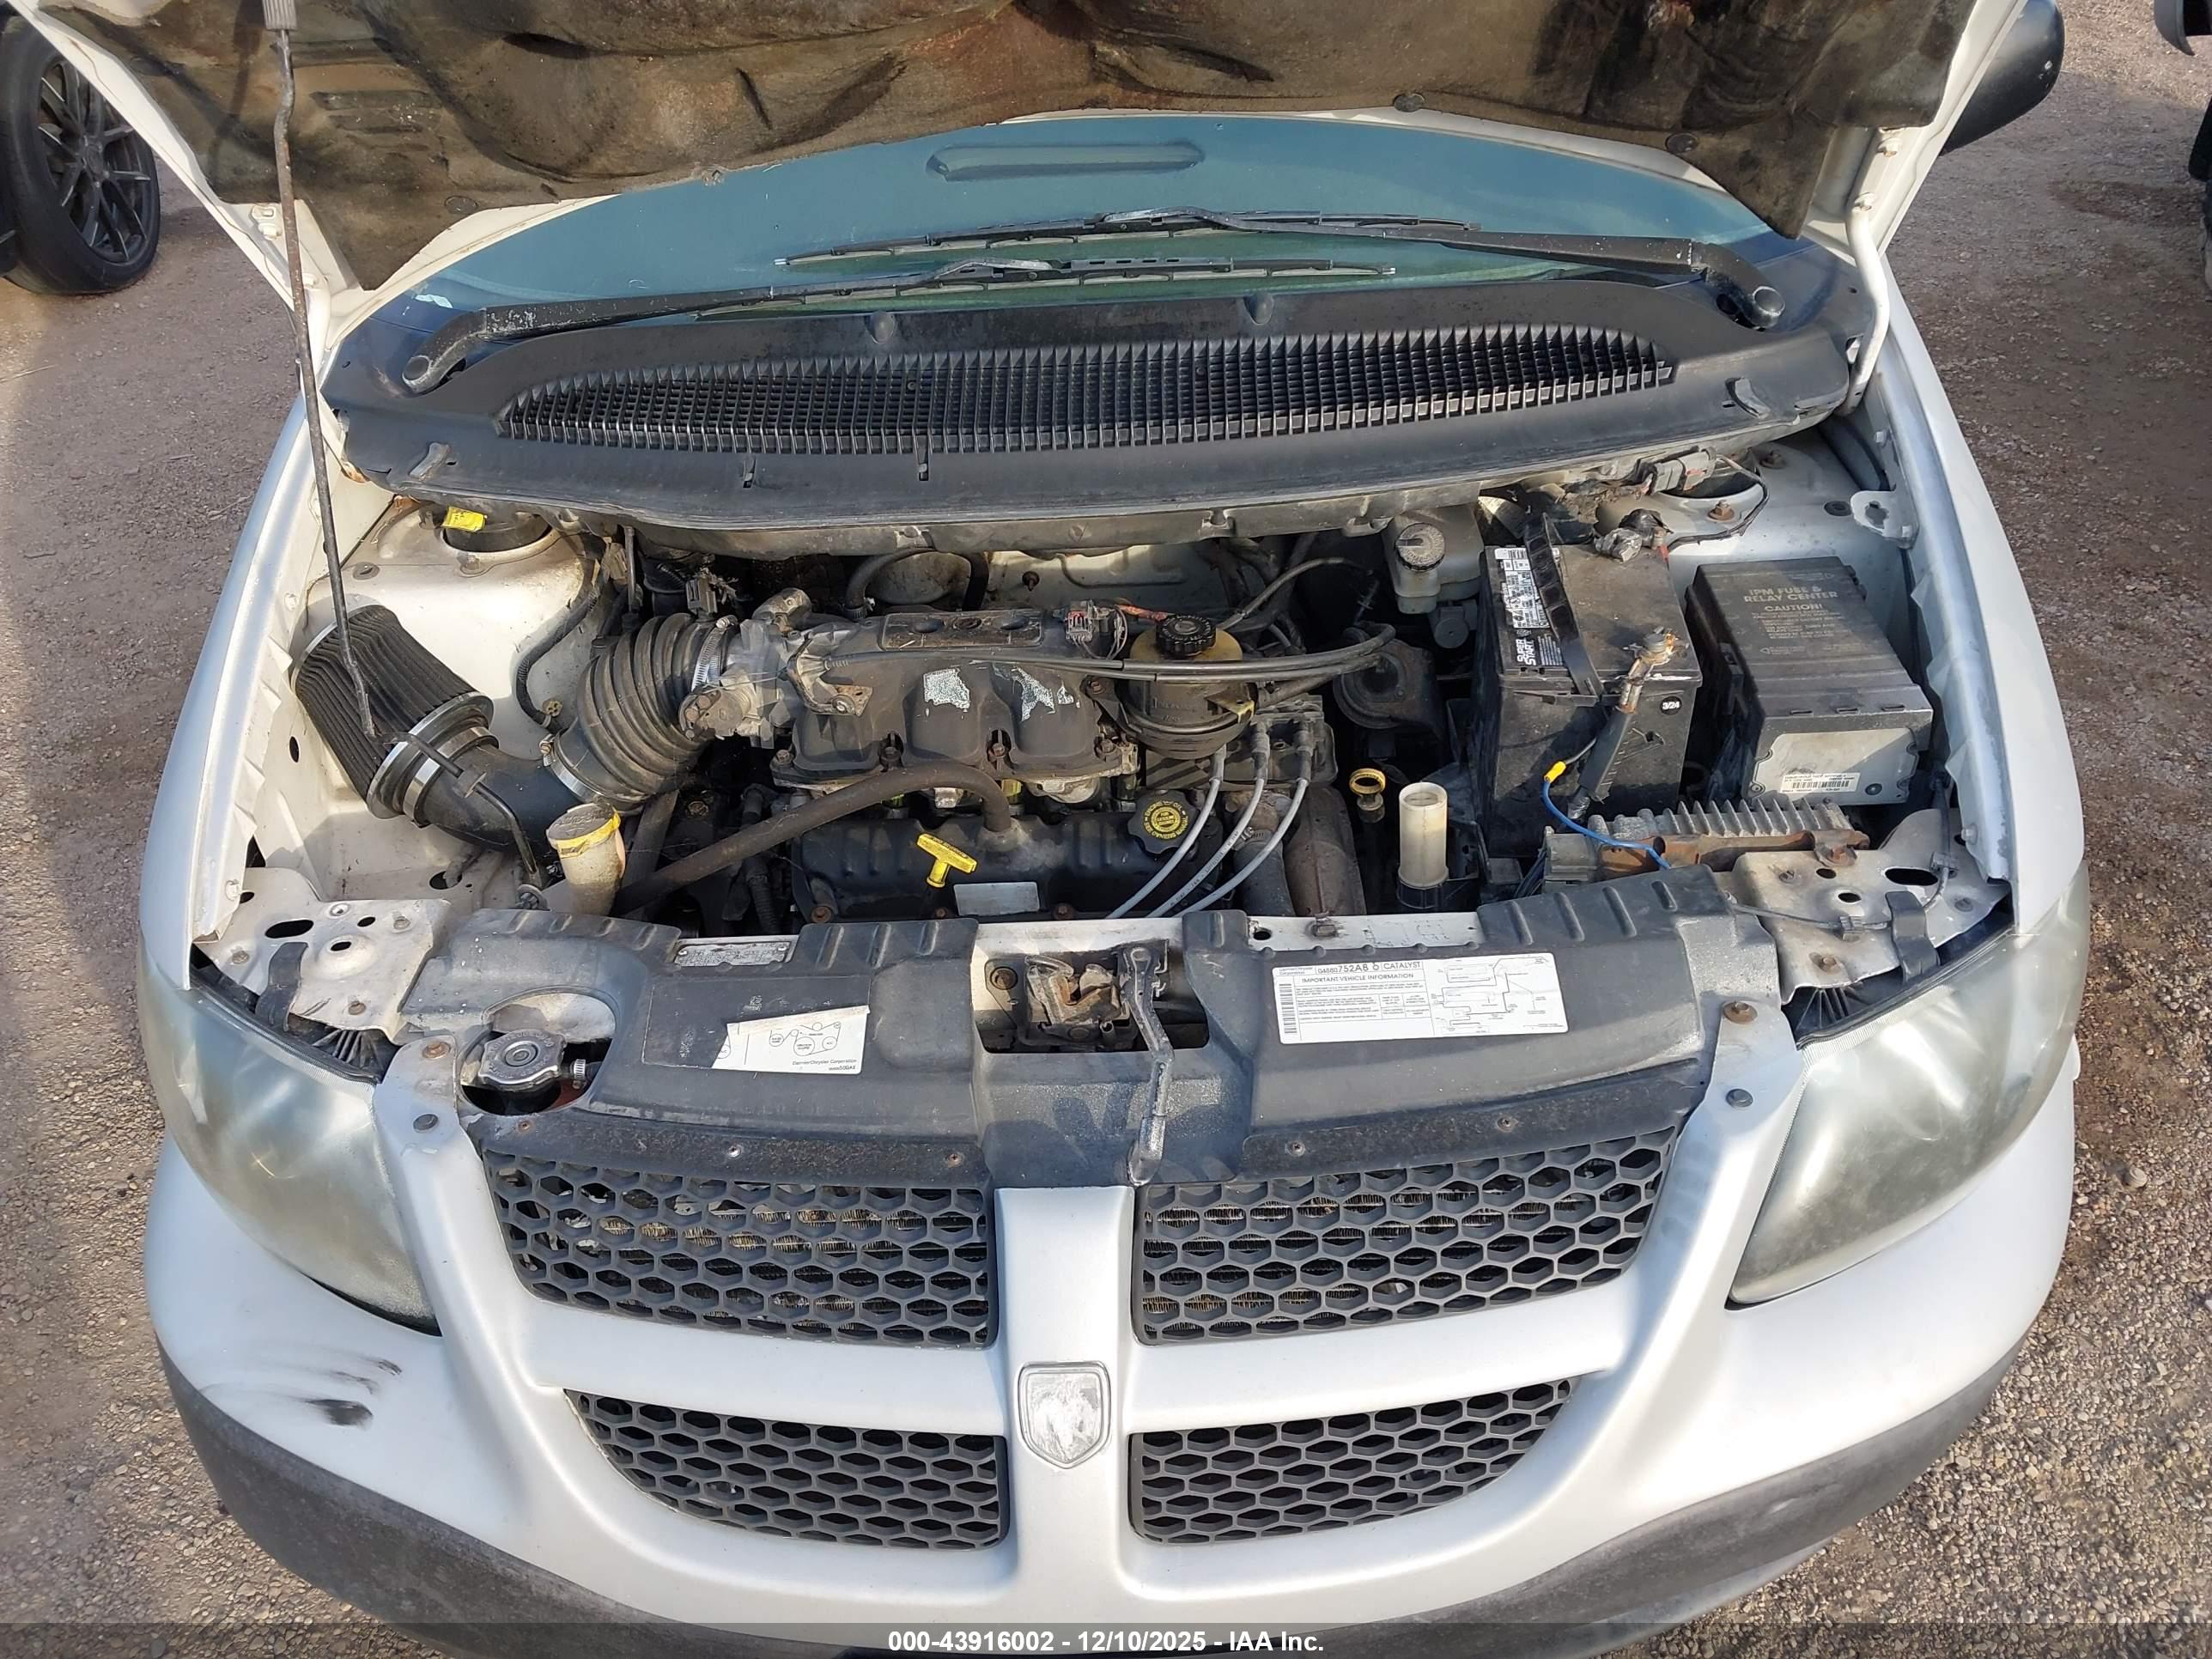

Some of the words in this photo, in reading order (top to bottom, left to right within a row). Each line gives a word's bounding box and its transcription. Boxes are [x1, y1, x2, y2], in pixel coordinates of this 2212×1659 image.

[1743, 594, 1783, 603] RELAY
[1787, 591, 1838, 601] CENTER
[1765, 603, 1823, 611] CAUTION!
[1515, 638, 1526, 662] SUPER
[1524, 639, 1536, 665] START
[1662, 701, 1680, 710] 3/24
[1173, 802, 1183, 811] OIL
[1383, 961, 1421, 969] CATALYST
